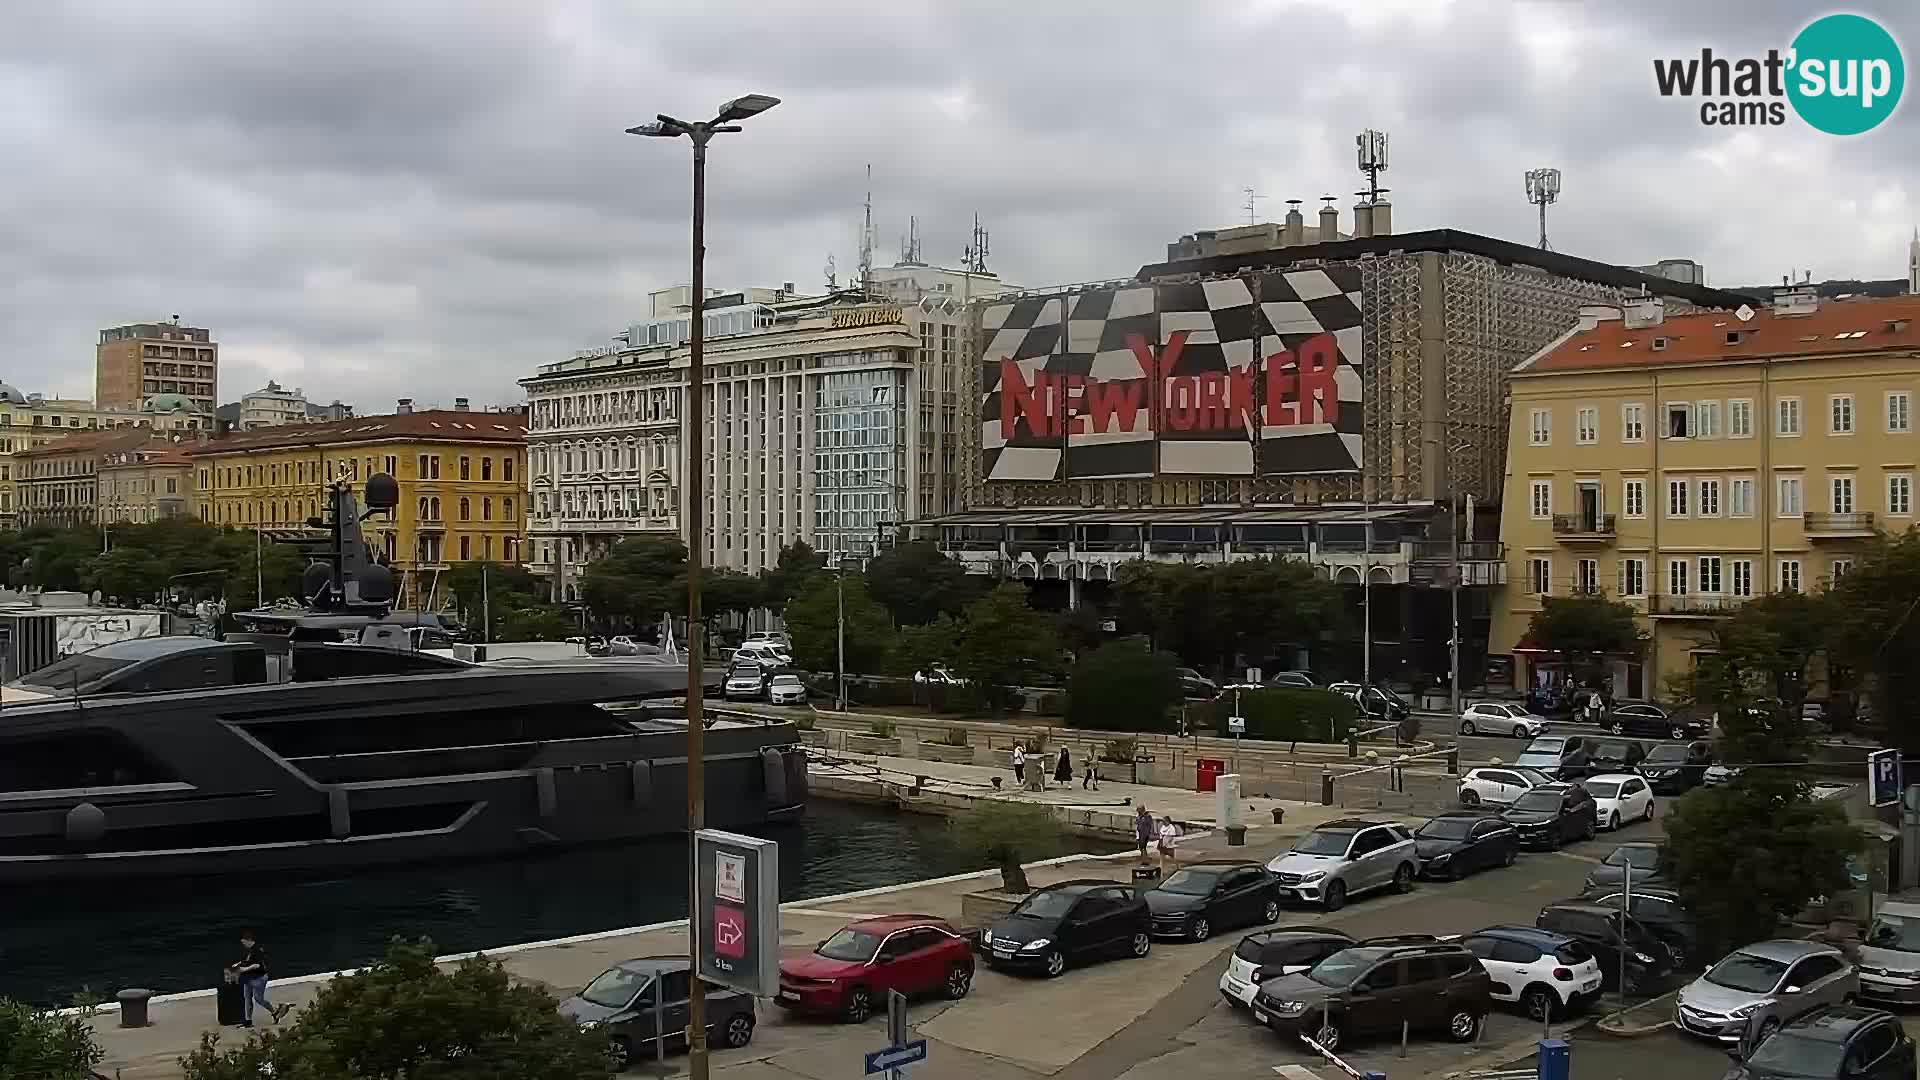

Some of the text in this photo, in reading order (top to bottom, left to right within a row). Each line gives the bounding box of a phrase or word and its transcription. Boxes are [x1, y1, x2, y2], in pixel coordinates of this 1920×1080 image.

[1000, 330, 1338, 440] NEW YORKER
[1880, 757, 1893, 782] P
[721, 959, 733, 971] km
